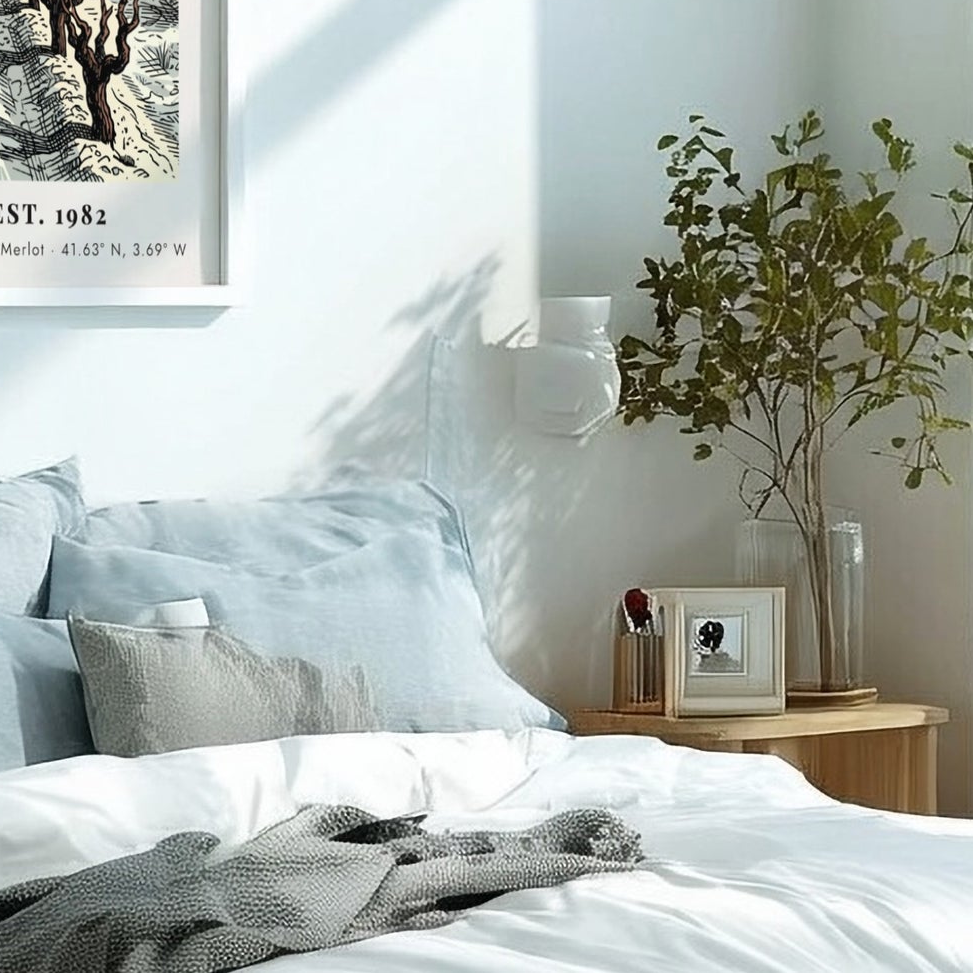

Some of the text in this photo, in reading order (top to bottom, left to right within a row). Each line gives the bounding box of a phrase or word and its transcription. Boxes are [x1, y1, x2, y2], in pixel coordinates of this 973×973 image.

[56, 204, 106, 229] 1982
[1, 241, 44, 256] Merlot
[61, 243, 105, 256] 41.63°
[111, 243, 126, 258] N,
[133, 243, 167, 256] 3.69°
[173, 243, 186, 256] W
